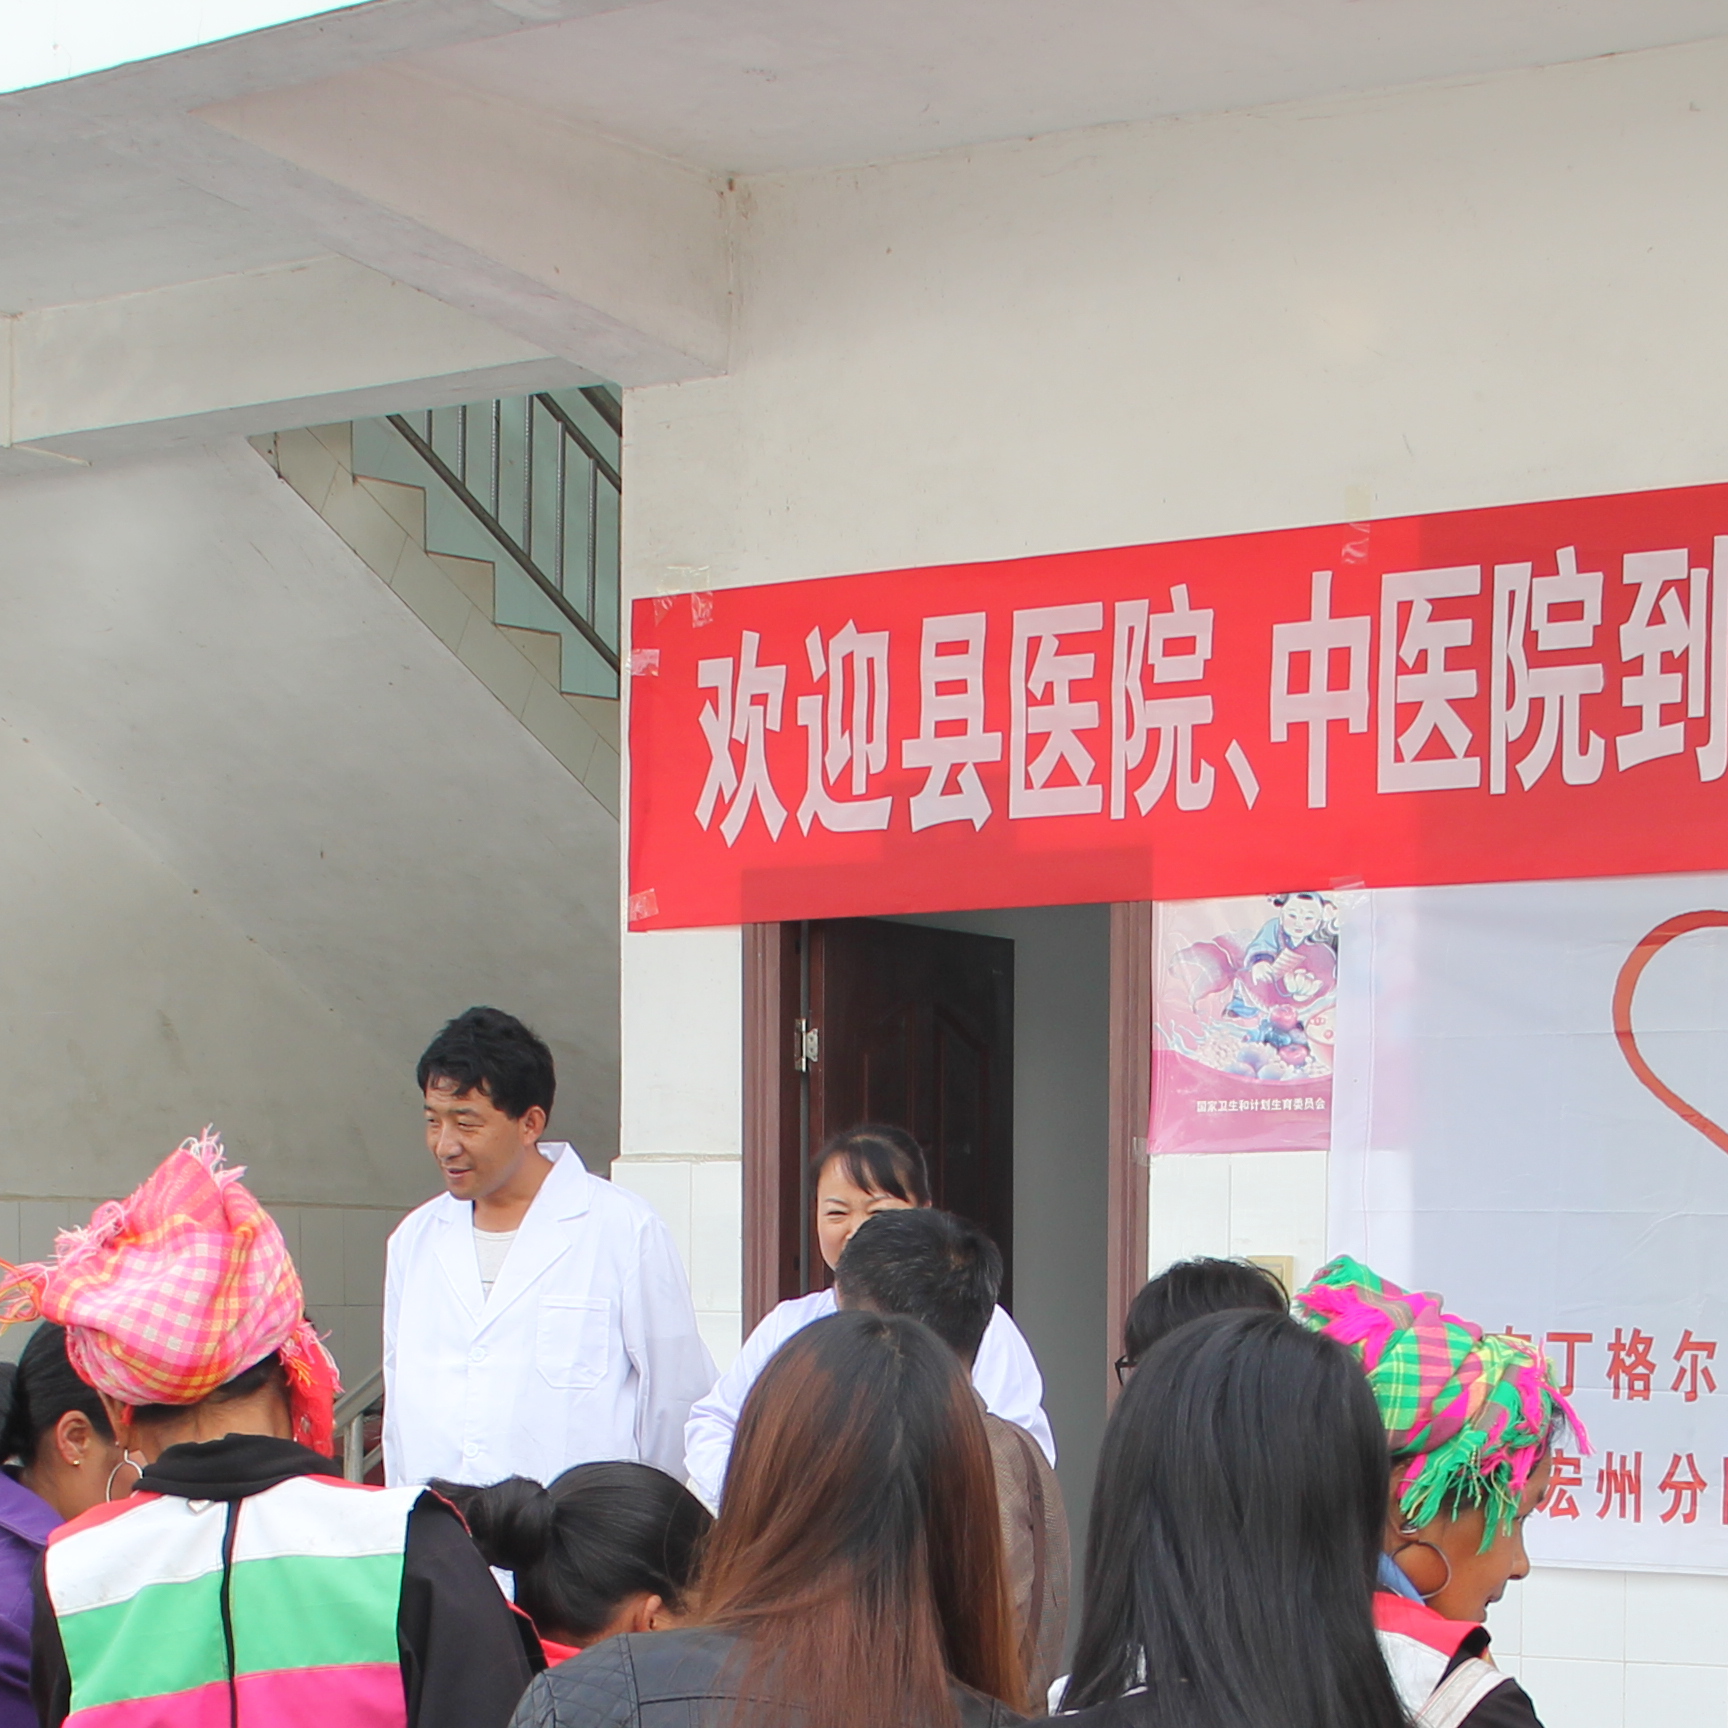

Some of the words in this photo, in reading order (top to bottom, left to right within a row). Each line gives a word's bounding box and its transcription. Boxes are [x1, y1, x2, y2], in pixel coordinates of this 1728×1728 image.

[1196, 1097, 1326, 1113] 国家卫生和计划生育委员会
